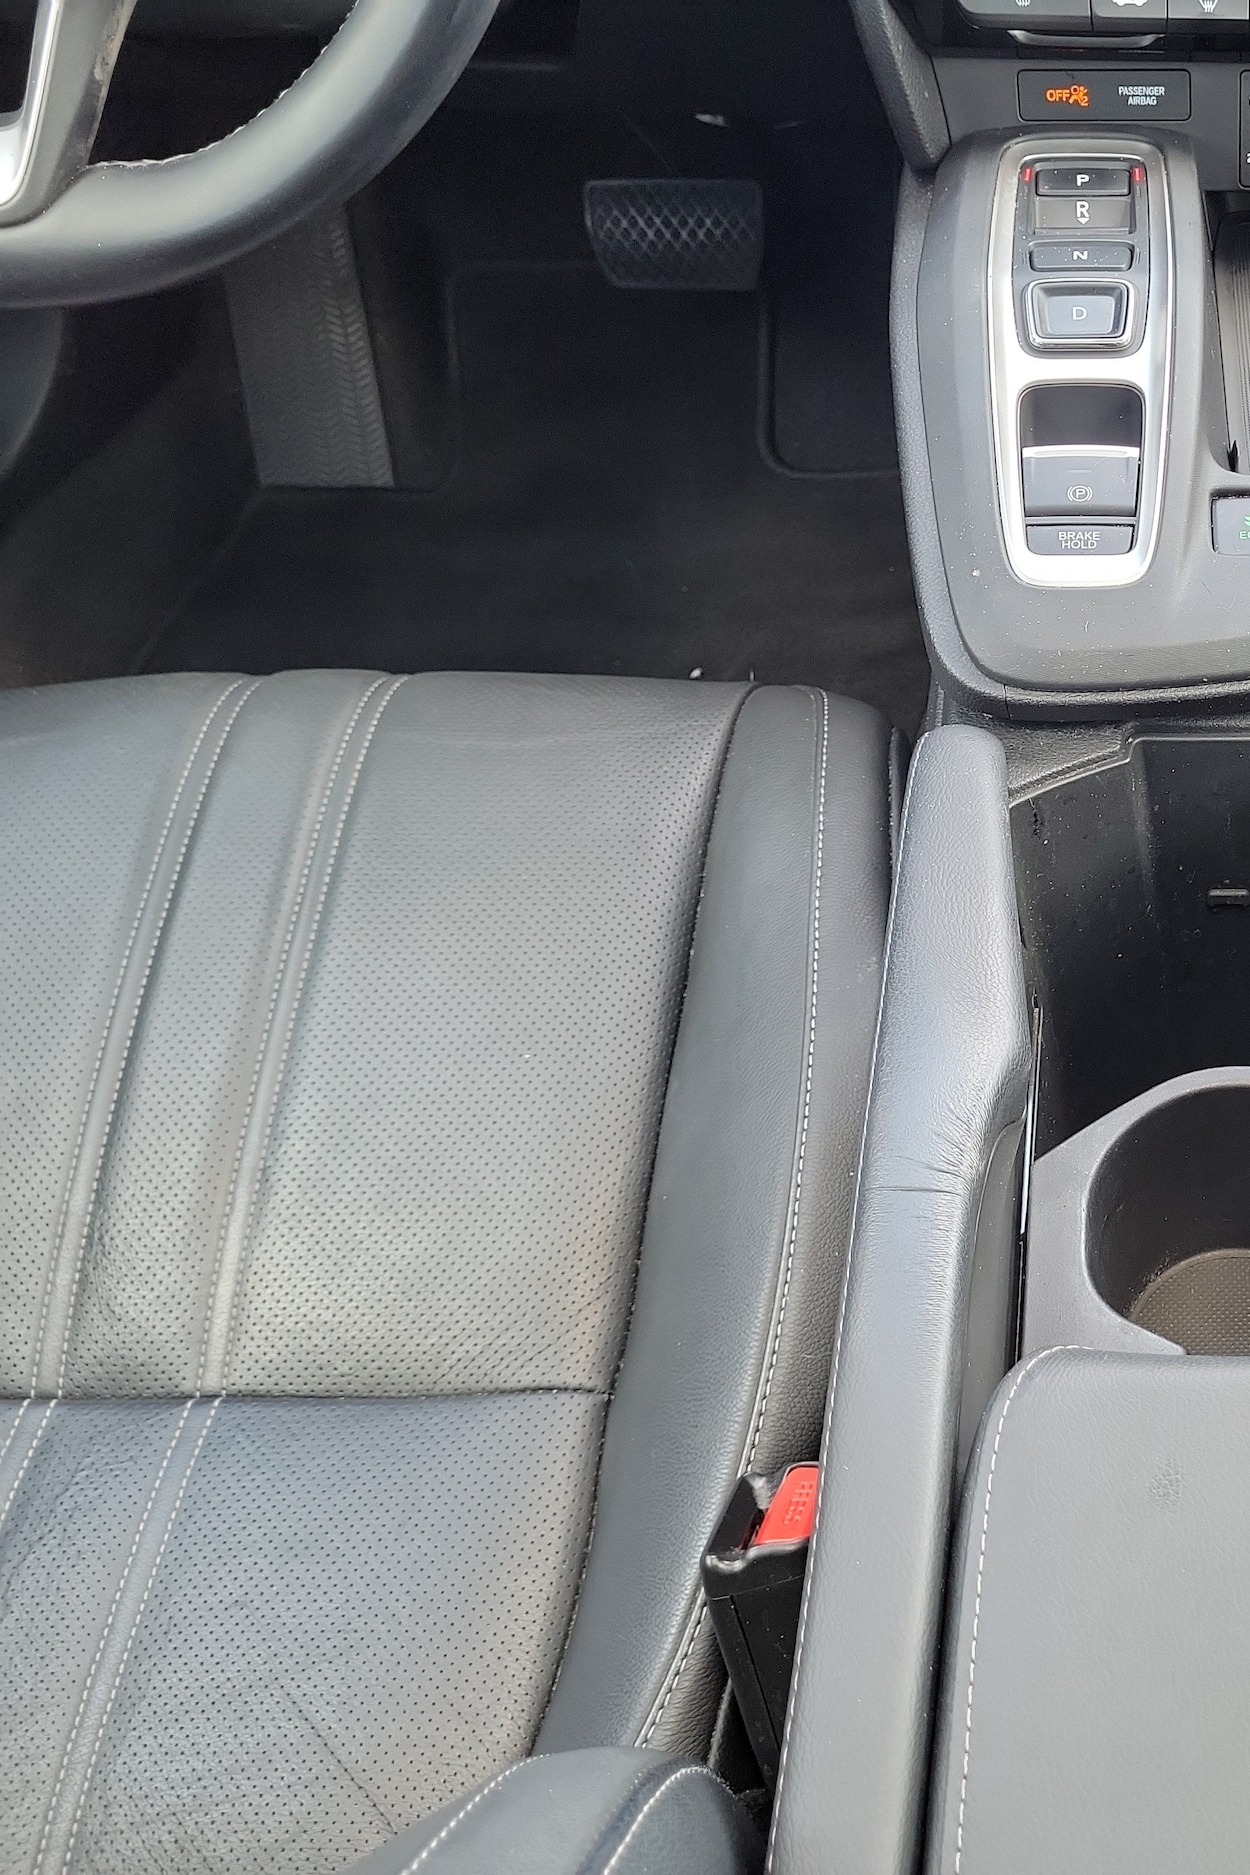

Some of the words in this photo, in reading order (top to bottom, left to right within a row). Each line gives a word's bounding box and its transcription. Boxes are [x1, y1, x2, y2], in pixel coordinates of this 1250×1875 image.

[1046, 89, 1070, 102] OFF
[1118, 86, 1165, 96] PASSENGER
[1127, 96, 1157, 106] AIRBAG
[1076, 174, 1090, 187] P
[1076, 201, 1090, 218] R
[1072, 250, 1088, 261] N
[1072, 306, 1087, 321] D
[1058, 531, 1101, 541] BRAKE
[1061, 540, 1097, 549] HOLD
